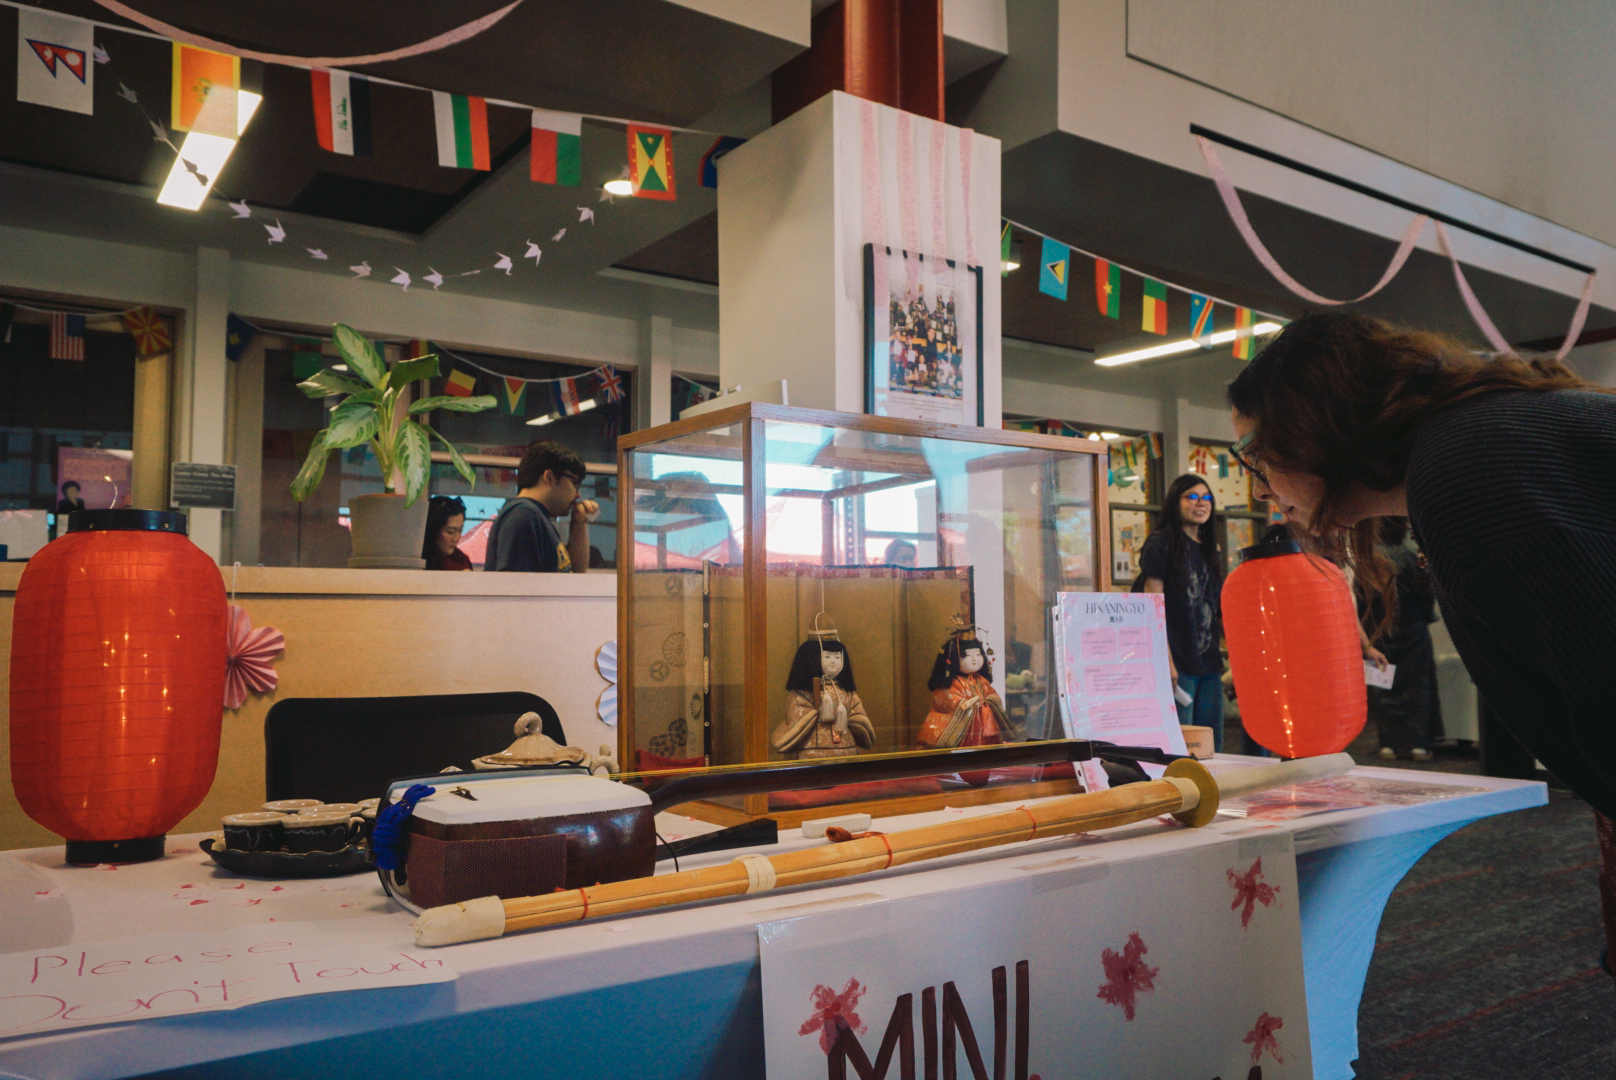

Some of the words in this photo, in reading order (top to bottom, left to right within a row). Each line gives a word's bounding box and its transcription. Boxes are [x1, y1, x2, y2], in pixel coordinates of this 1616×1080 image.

[1086, 602, 1145, 614] HINANINGYO
[0, 978, 257, 1034] Don't
[275, 952, 444, 983] Touch
[31, 941, 293, 983] Please
[826, 959, 1030, 1080] MINI
